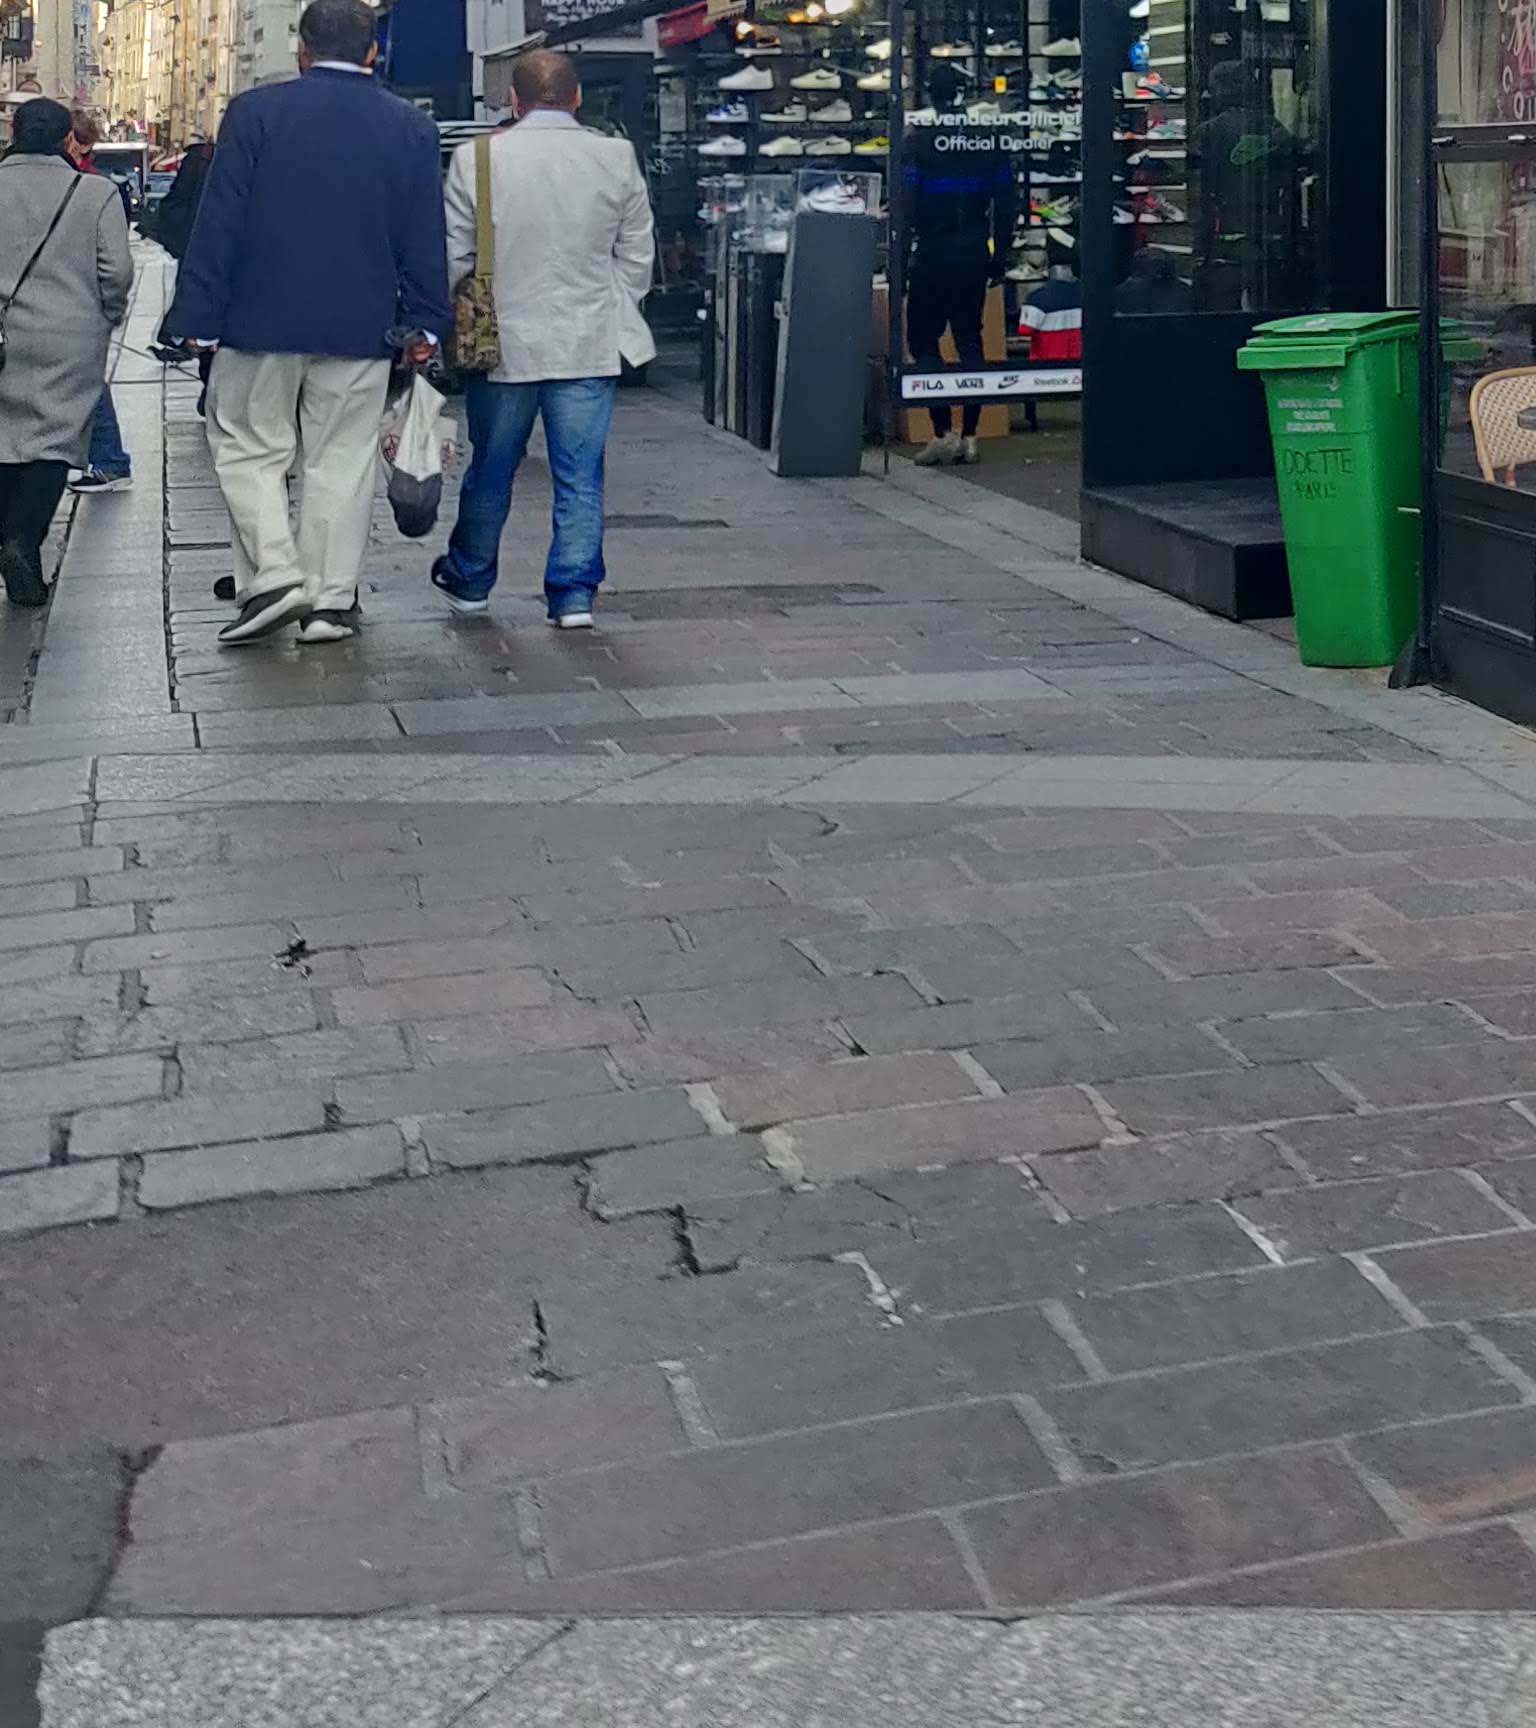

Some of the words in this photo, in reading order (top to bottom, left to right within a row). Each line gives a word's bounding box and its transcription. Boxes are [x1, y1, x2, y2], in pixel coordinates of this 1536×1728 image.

[904, 111, 1012, 127] Revendeur
[934, 135, 995, 152] Official
[998, 135, 1054, 152] Dealer
[912, 380, 944, 392] FILA
[955, 378, 984, 389] VANS
